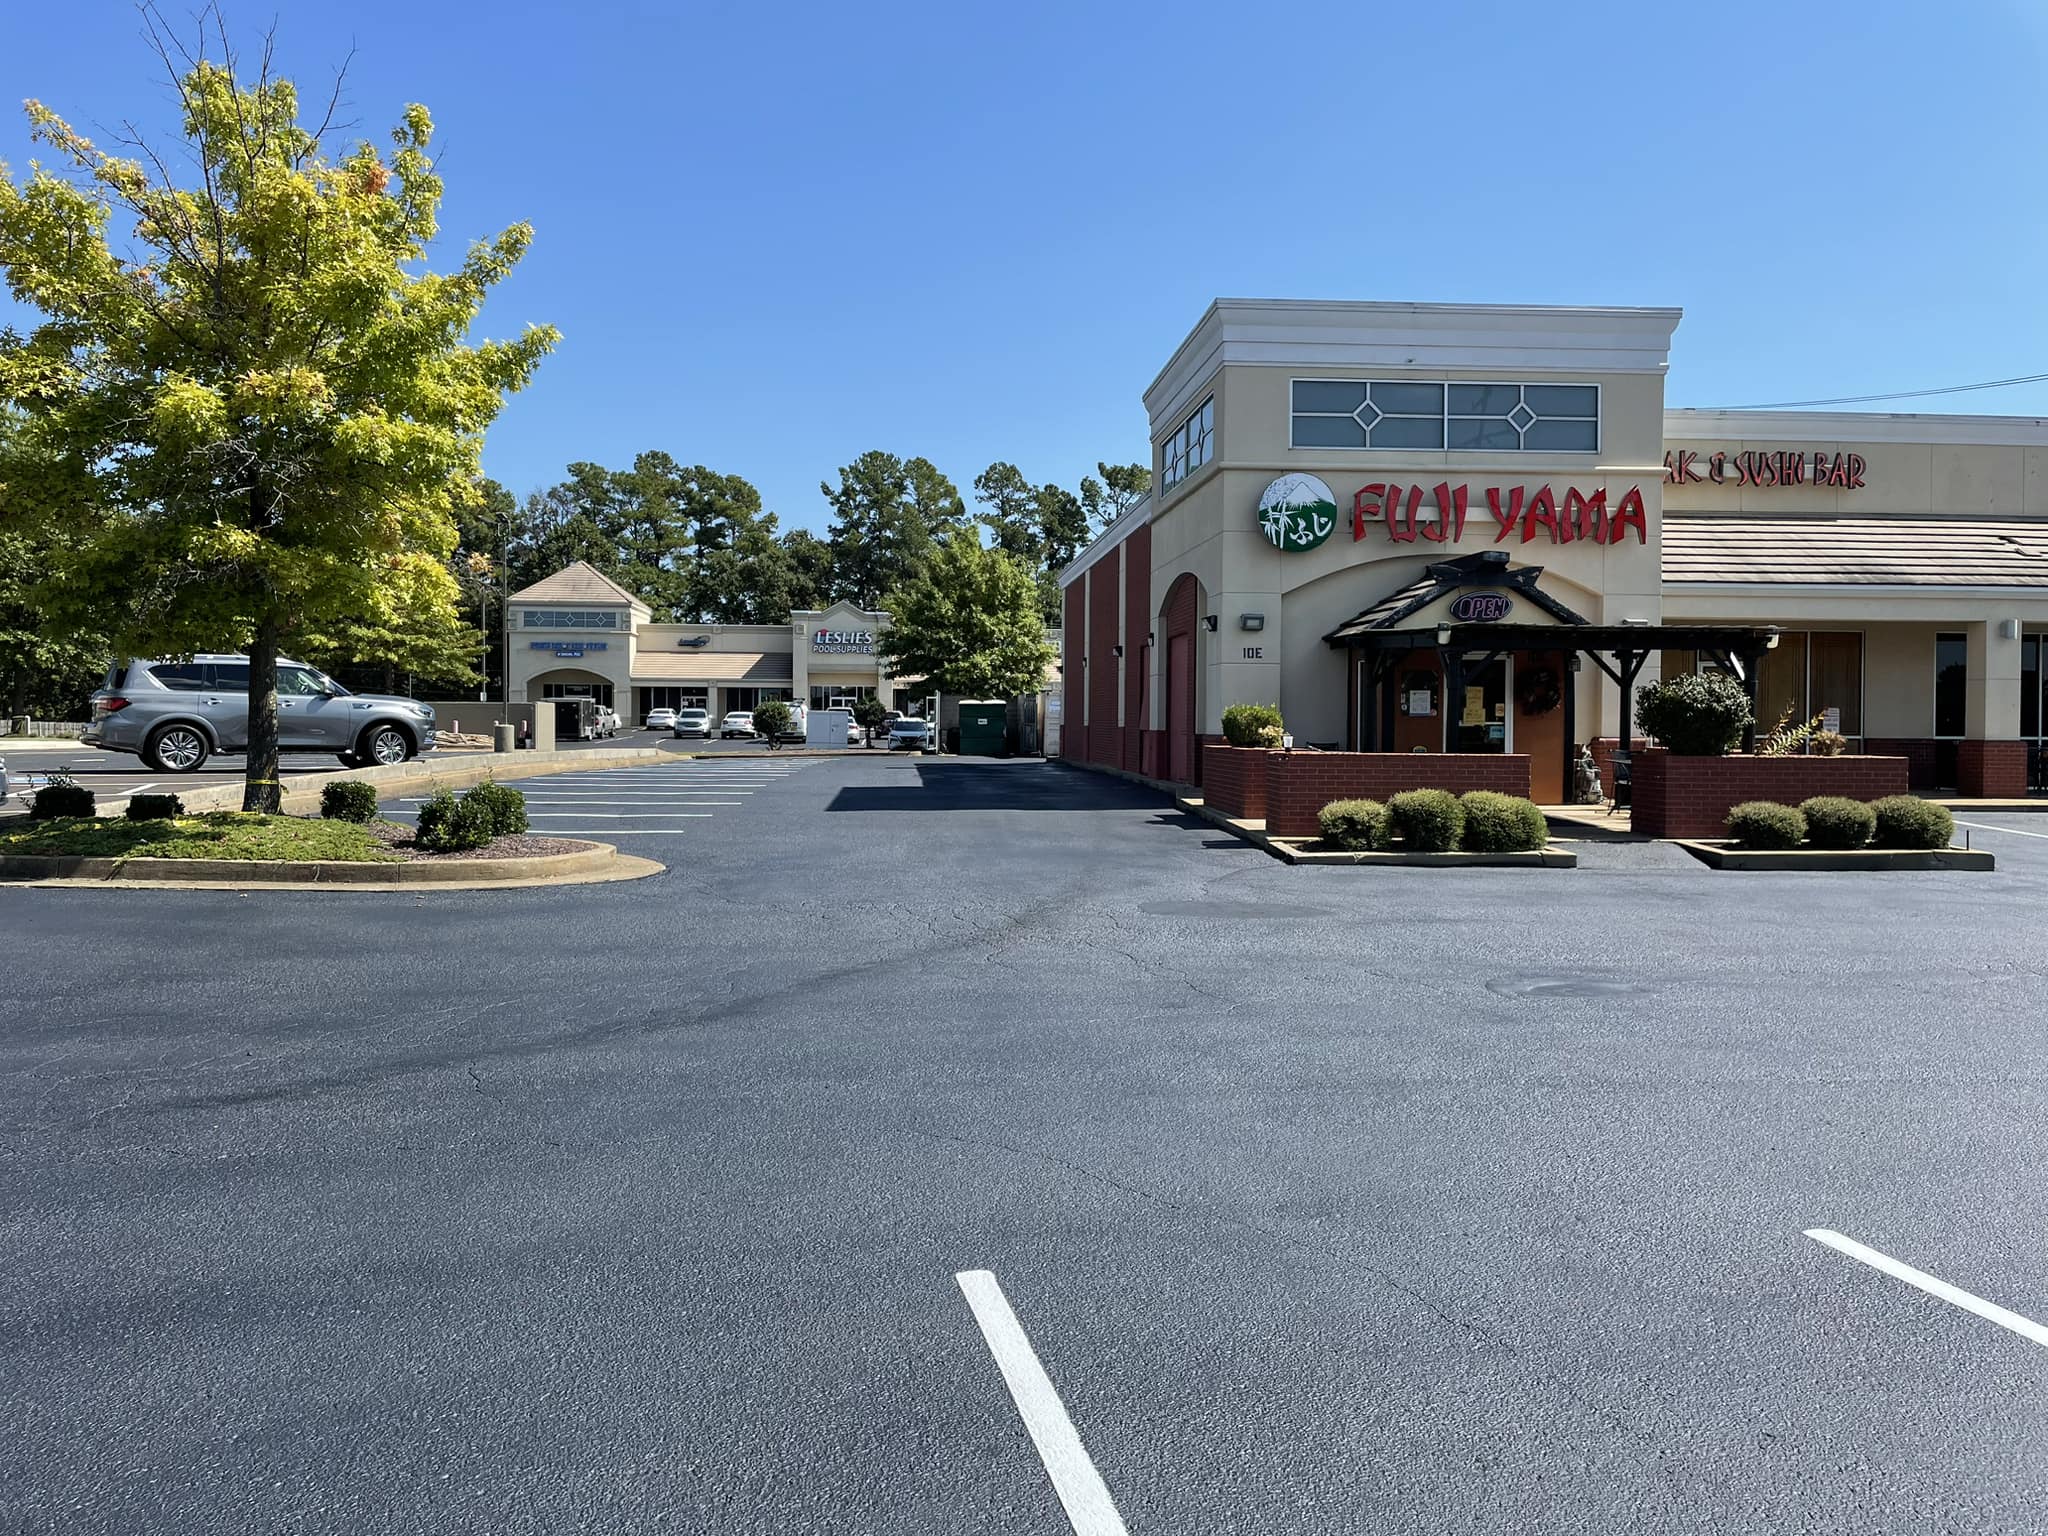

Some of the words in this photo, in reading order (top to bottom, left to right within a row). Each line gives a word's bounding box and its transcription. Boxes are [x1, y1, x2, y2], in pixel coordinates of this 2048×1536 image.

[1709, 451, 1727, 485] &
[1733, 450, 1805, 487] SUSHI
[1813, 451, 1867, 489] BAR
[1353, 482, 1467, 543] FUJI
[1486, 483, 1647, 544] YAMA
[1460, 598, 1505, 618] OPEN
[816, 630, 872, 644] LESLIE'S
[813, 645, 835, 653] POOL
[837, 645, 873, 653] SUPPLIES
